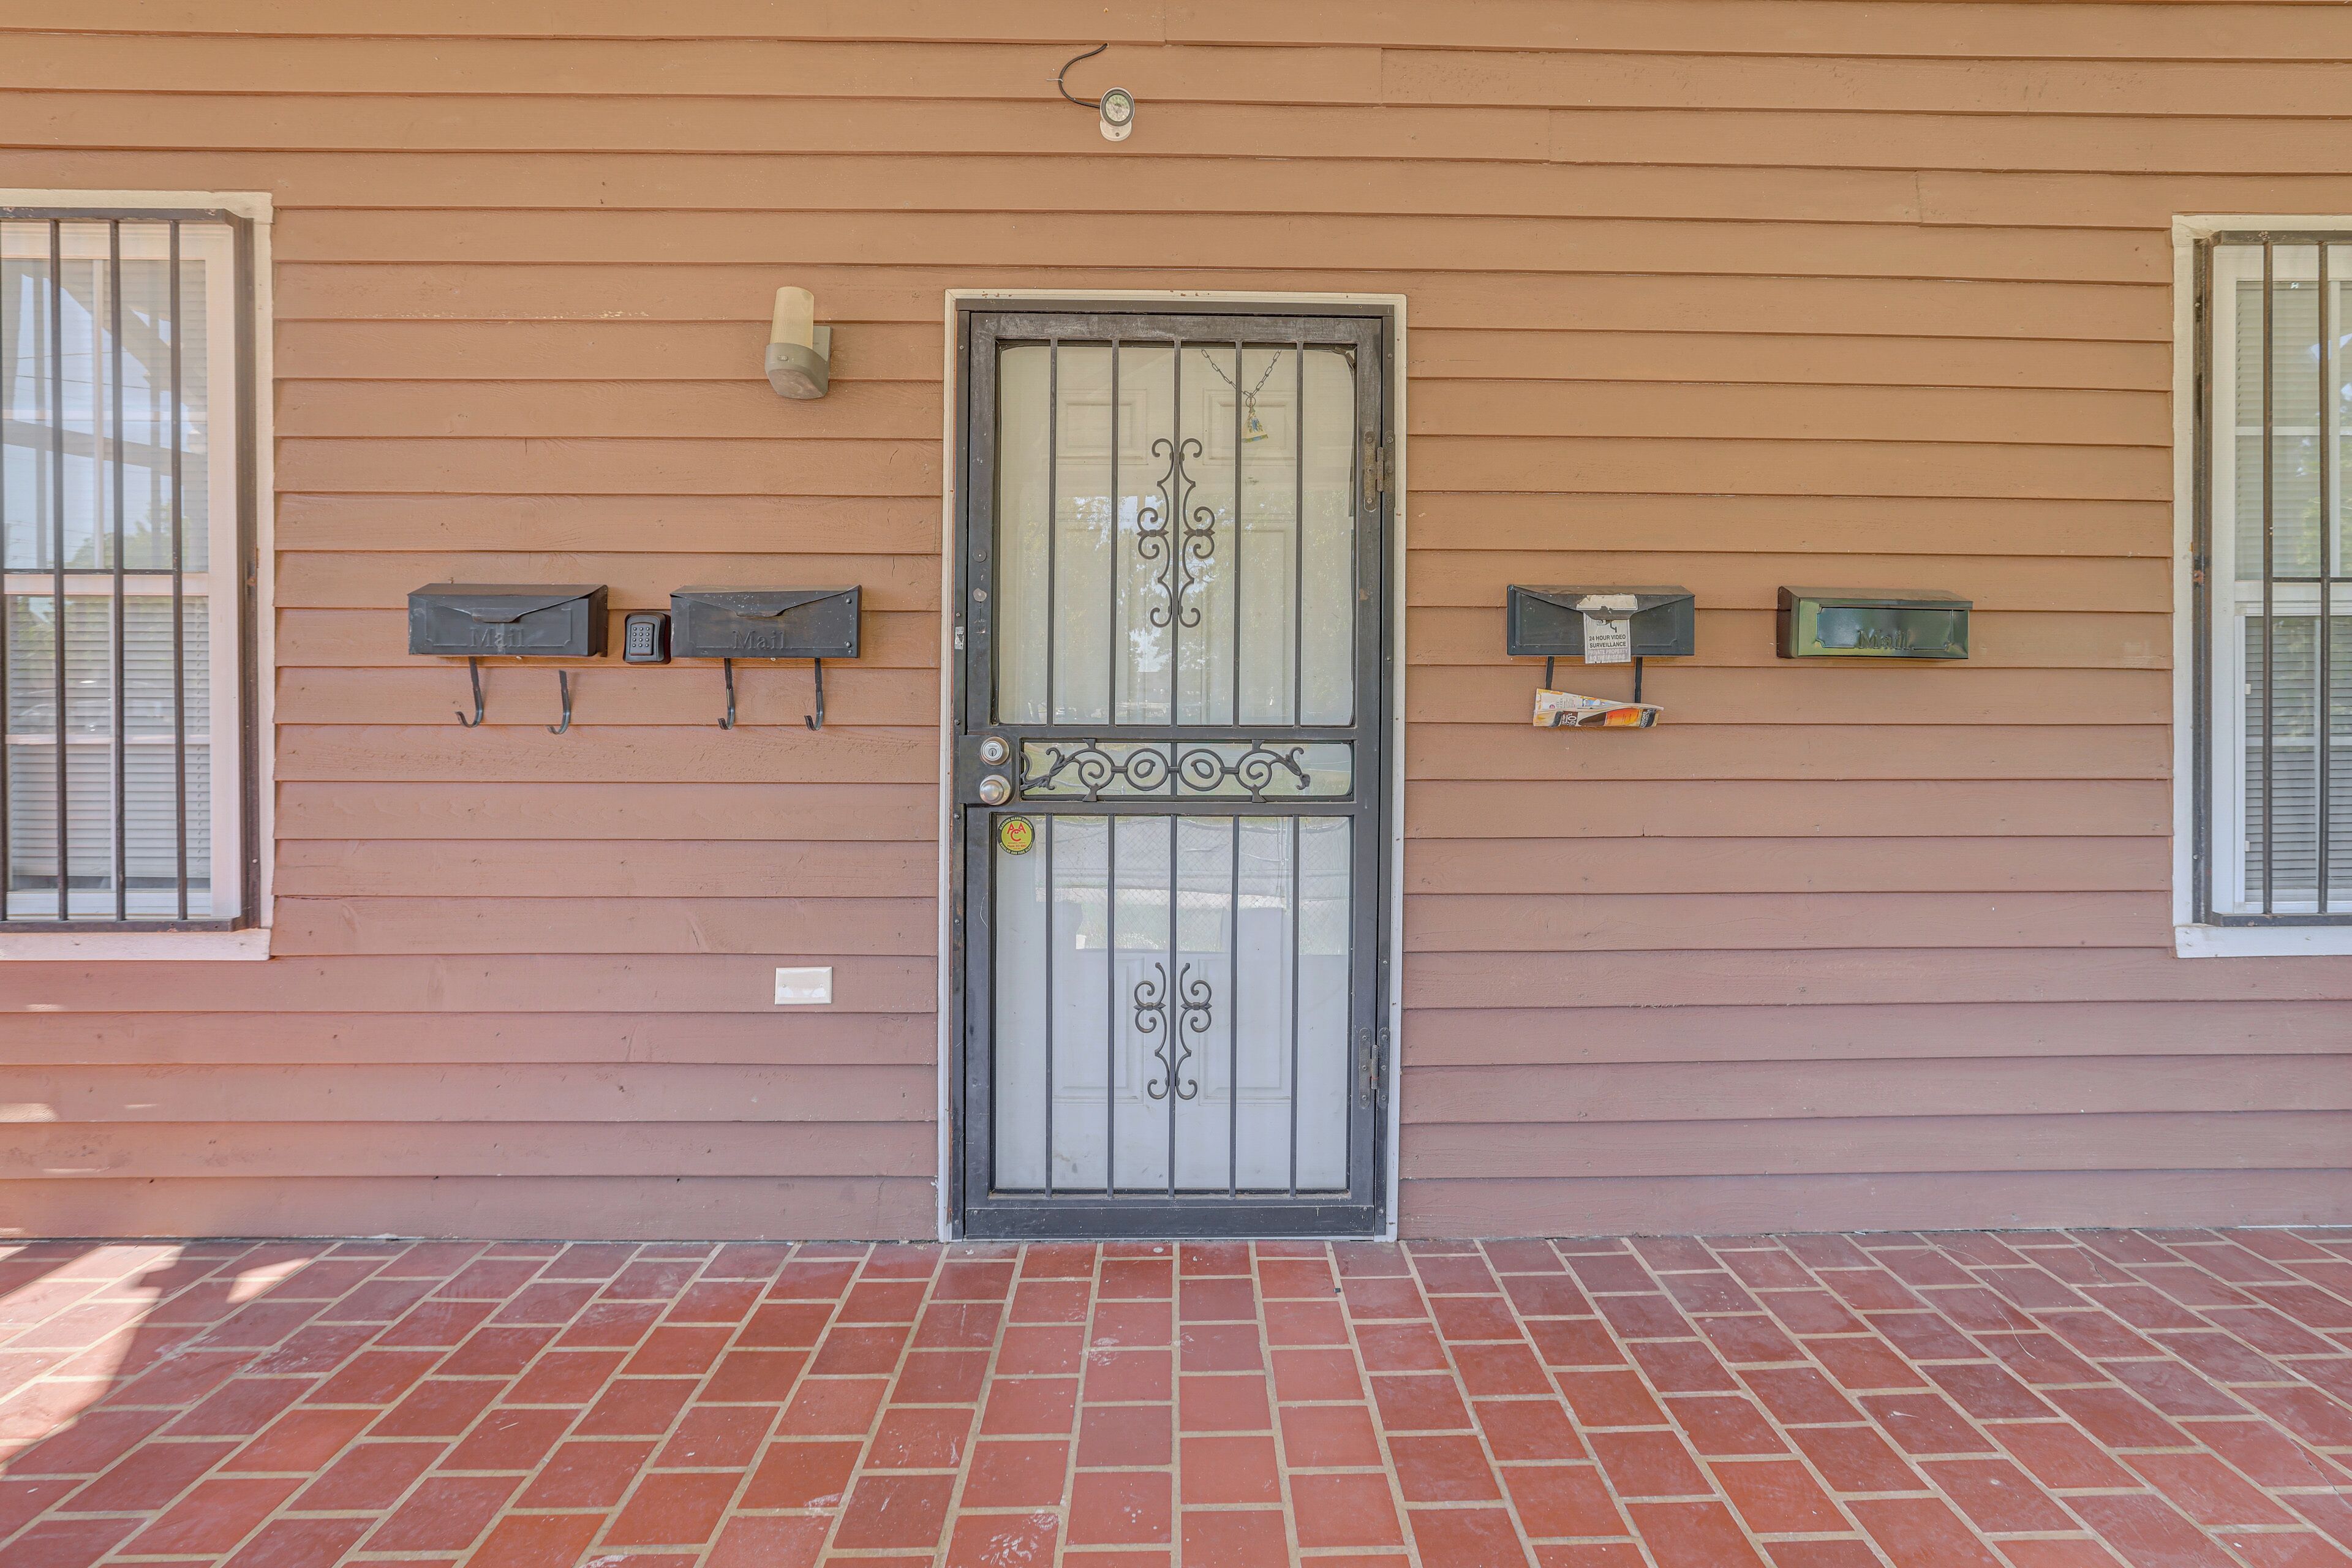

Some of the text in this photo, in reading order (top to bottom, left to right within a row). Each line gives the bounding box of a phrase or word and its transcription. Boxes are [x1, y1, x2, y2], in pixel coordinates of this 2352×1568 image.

[470, 627, 525, 647] Mail
[733, 630, 787, 649] Mail
[1857, 629, 1910, 650] Mail
